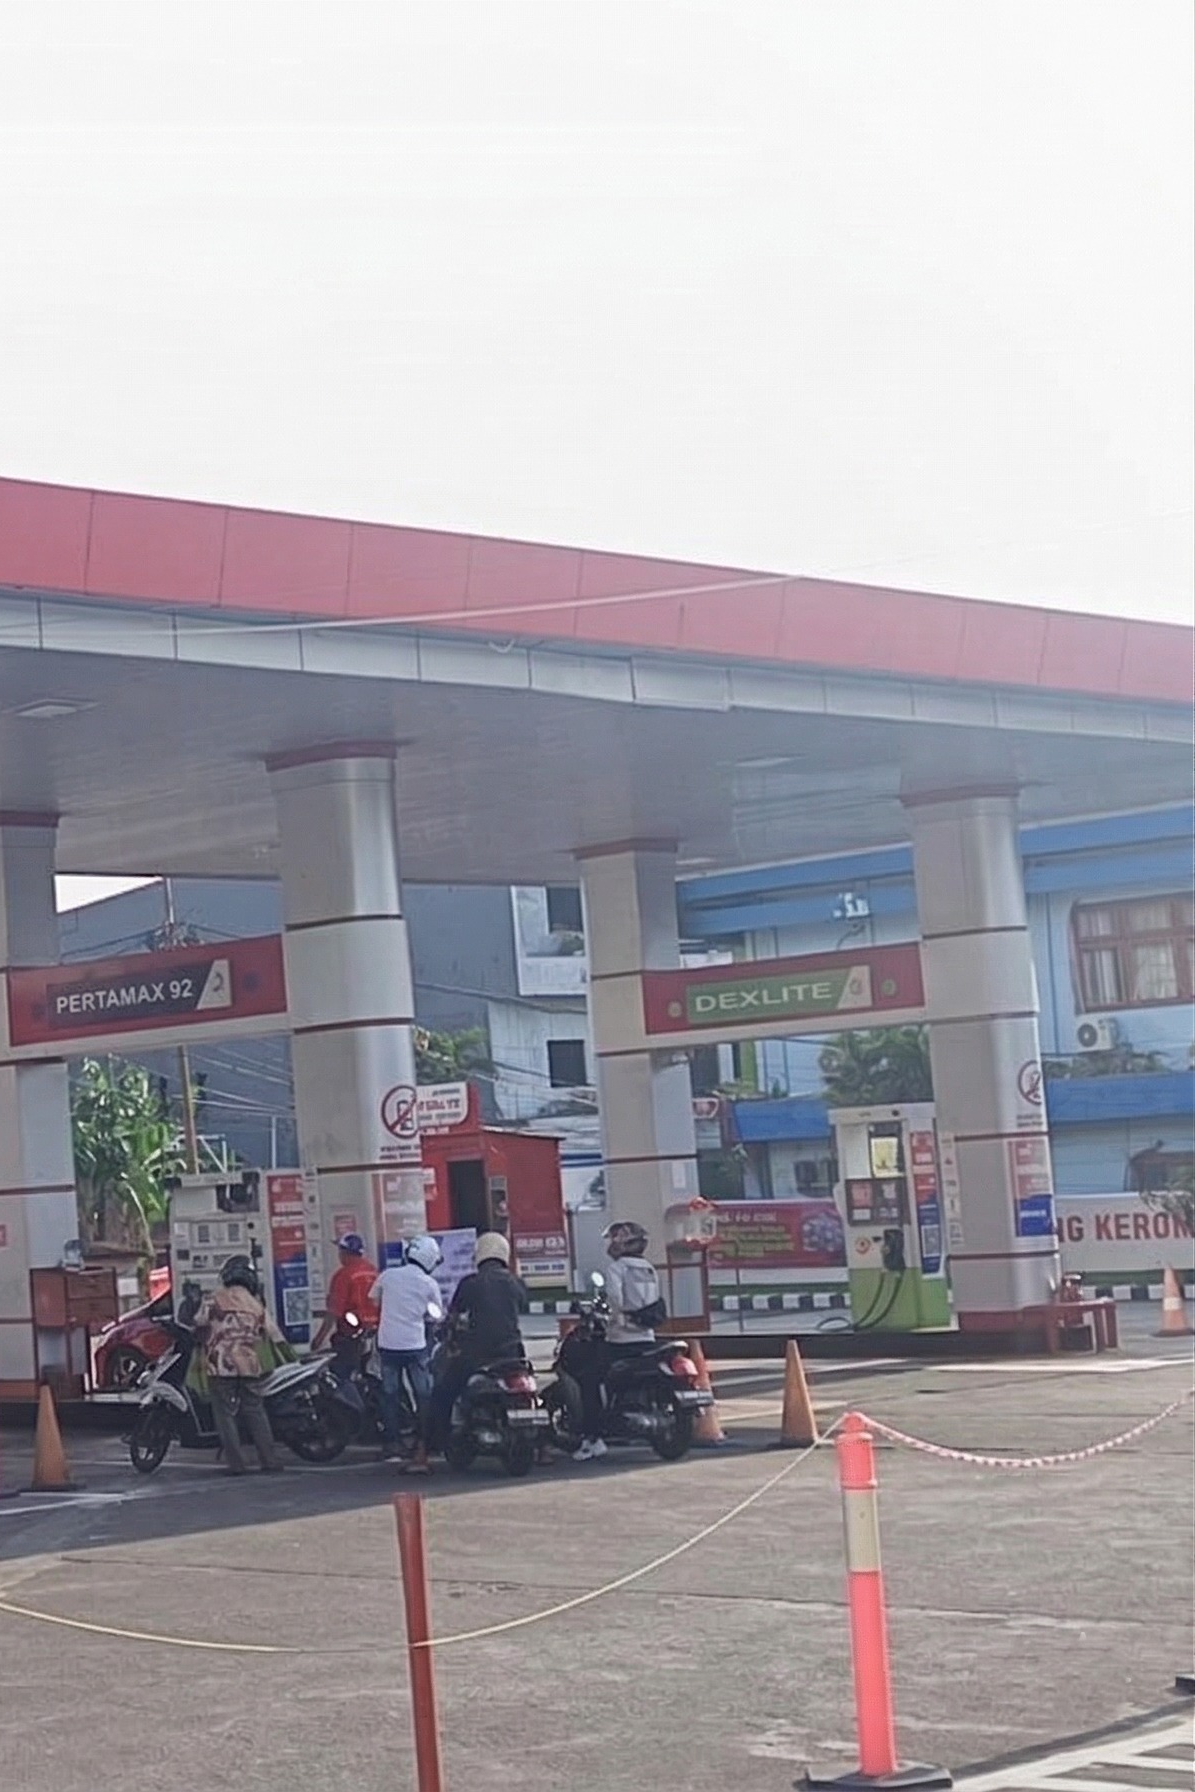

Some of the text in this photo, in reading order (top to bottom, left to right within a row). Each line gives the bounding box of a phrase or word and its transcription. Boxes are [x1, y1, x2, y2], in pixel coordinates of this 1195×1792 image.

[56, 978, 193, 1015] PERTAMAX 92
[695, 982, 833, 1013] DEXLITE
